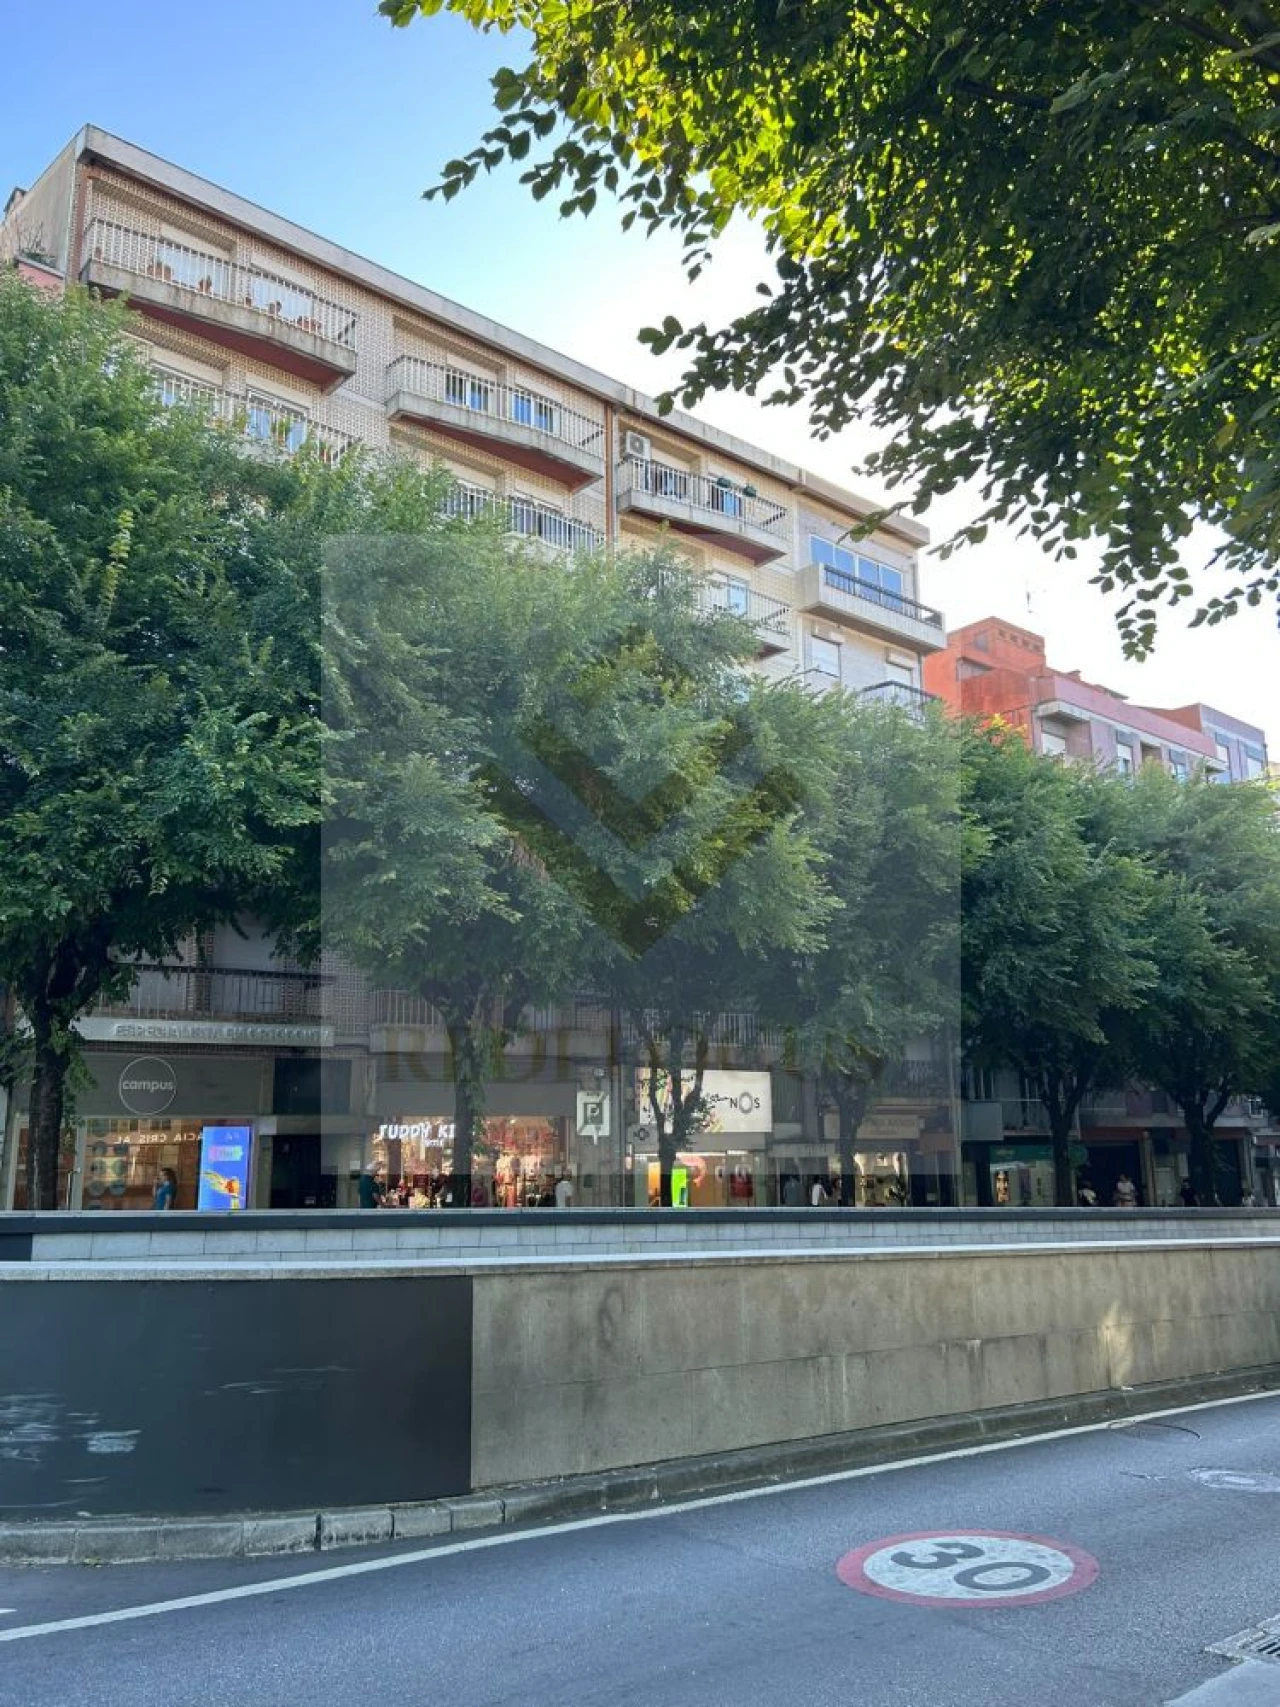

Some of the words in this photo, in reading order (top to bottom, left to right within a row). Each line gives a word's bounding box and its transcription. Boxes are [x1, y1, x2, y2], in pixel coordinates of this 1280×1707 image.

[122, 1079, 173, 1093] campus
[729, 1091, 761, 1114] NOS
[890, 1541, 1052, 1592] 30
